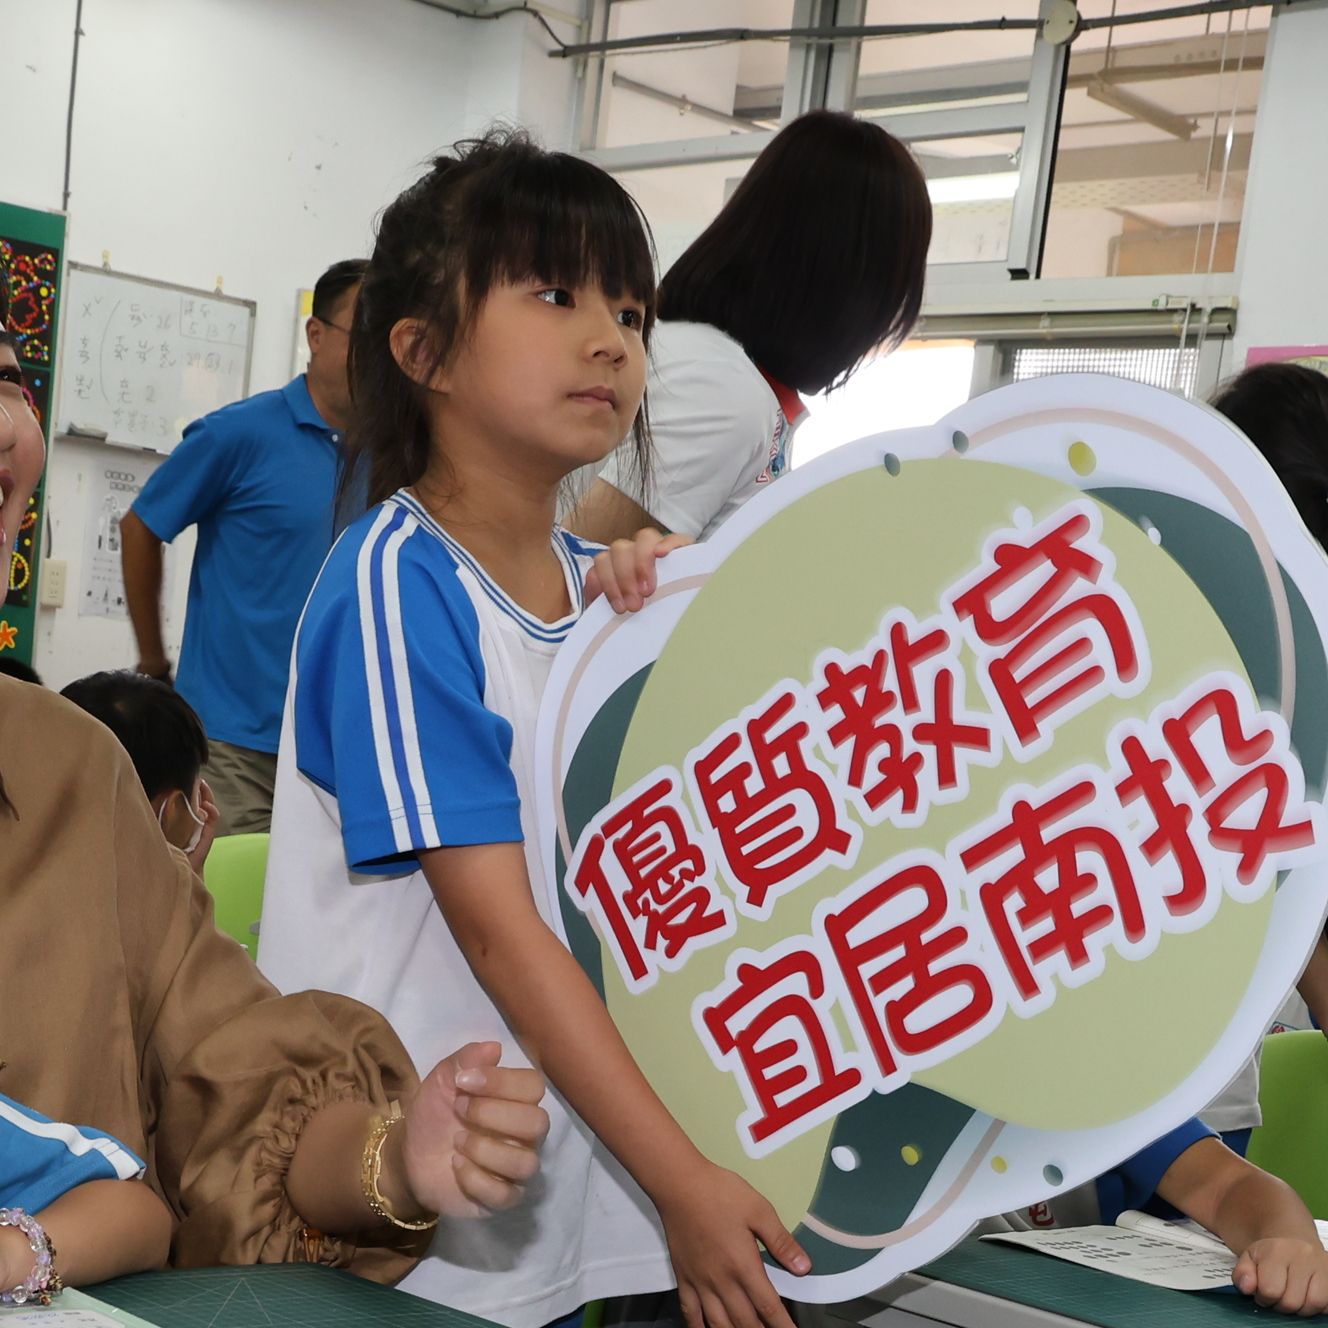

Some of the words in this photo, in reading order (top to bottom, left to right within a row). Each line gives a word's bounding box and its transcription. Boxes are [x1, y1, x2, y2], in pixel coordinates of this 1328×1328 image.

[574, 512, 1140, 981] 優質教育
[702, 686, 1317, 1146] 宜居南投
